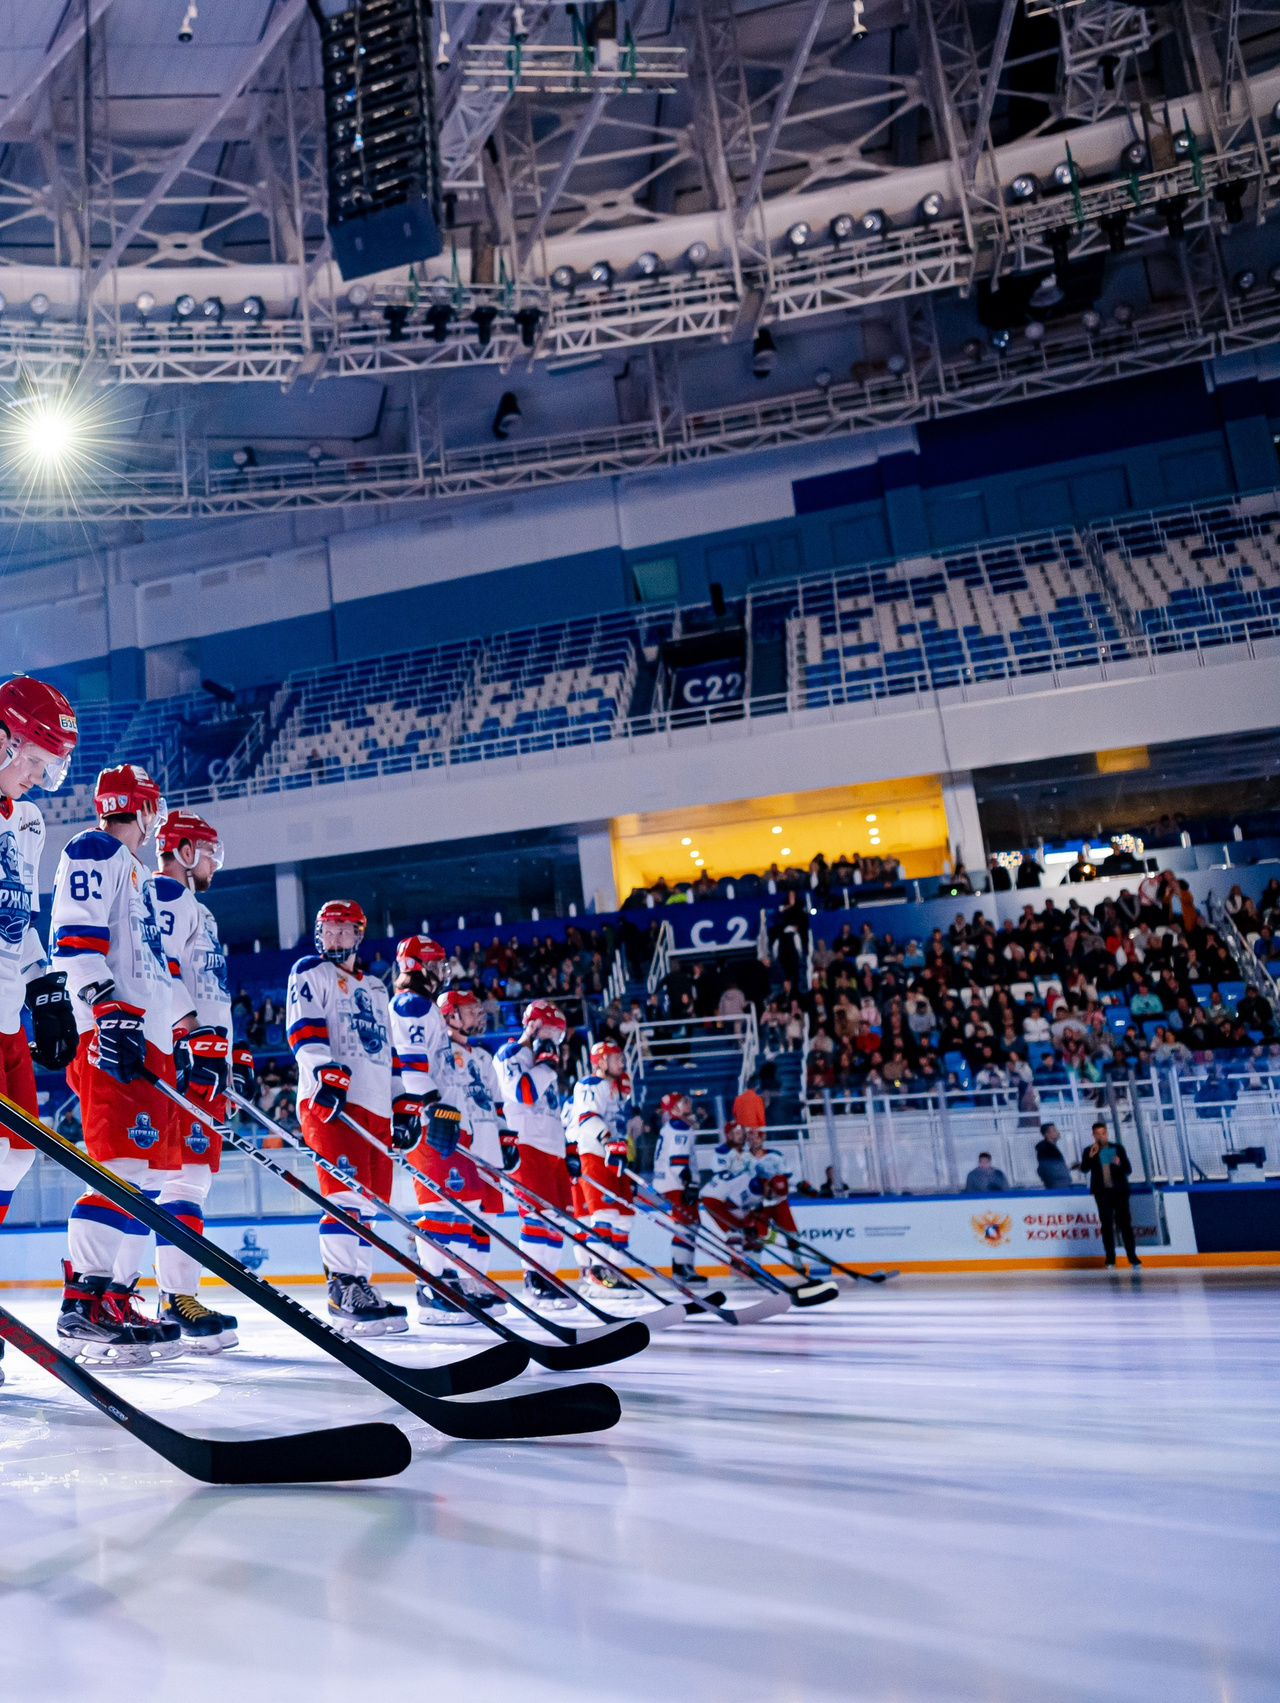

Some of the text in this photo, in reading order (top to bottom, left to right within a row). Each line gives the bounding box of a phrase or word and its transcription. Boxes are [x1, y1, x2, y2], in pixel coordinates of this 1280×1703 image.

[683, 671, 742, 704] C22
[102, 797, 117, 813] 83
[290, 982, 313, 1005] 24
[210, 1116, 286, 1178] VAPOR
[1026, 1228, 1090, 1241] ХОККЕЯ
